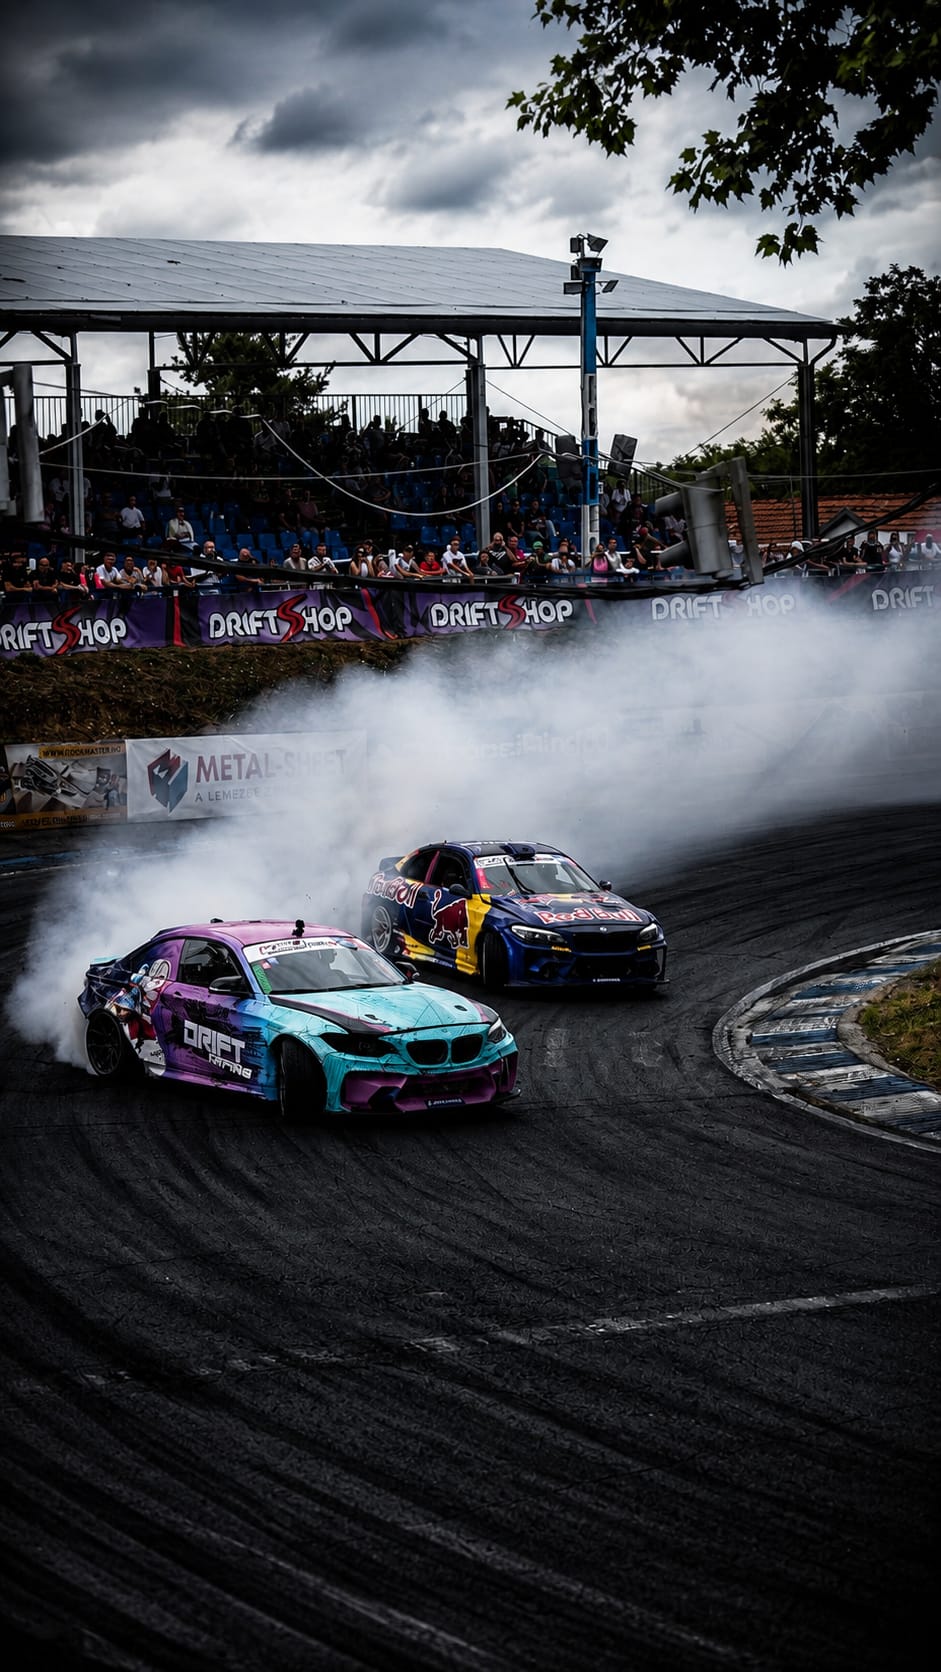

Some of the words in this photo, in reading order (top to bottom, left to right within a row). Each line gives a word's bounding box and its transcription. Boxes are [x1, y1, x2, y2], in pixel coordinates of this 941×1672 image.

[0, 606, 127, 654] RIFTSHOP
[534, 907, 594, 924] Red
[591, 907, 643, 922] Bull
[183, 1020, 246, 1063] DRIFT
